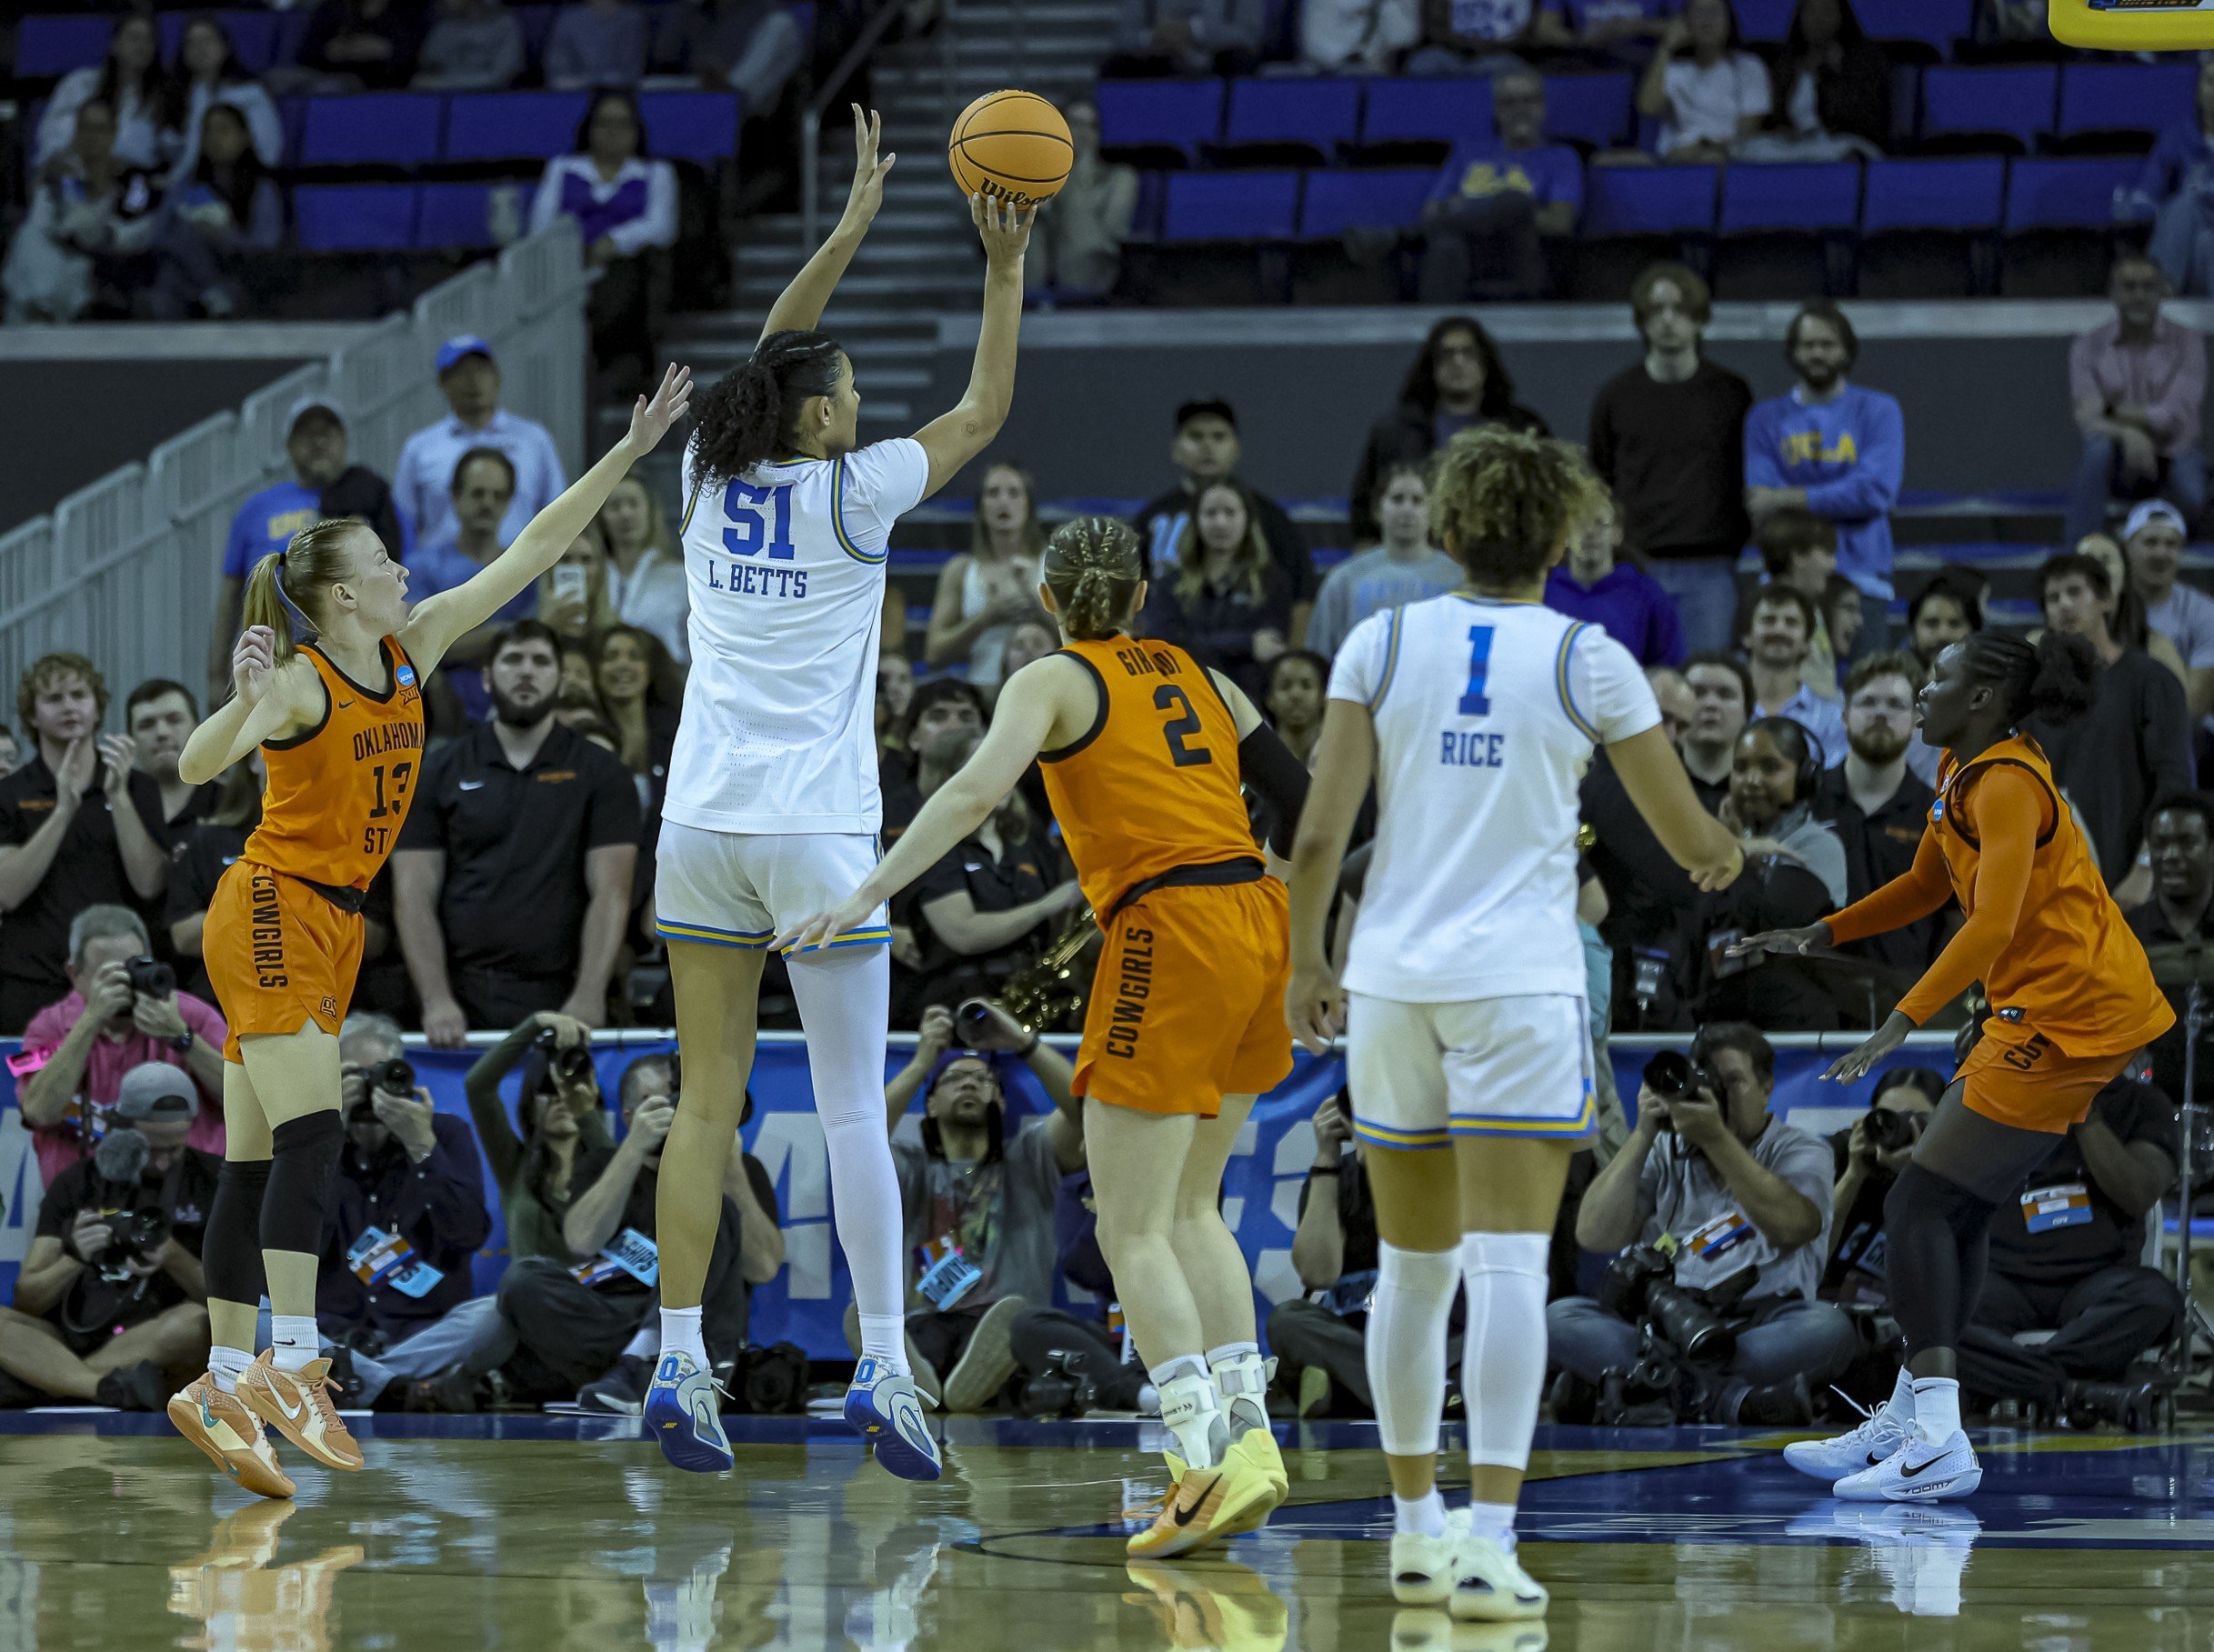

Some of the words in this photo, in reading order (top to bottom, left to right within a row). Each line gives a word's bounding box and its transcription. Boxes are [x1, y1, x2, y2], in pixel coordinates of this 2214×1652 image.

[980, 177, 1055, 206] Wilson
[723, 476, 795, 560] 51
[709, 560, 724, 589] L.
[729, 564, 807, 598] BETTS
[1458, 626, 1495, 716] 1
[1153, 685, 1212, 767] 2
[1441, 731, 1505, 767] RICE
[370, 762, 412, 818] 13
[252, 876, 288, 988] COWGIRLS
[1106, 926, 1155, 1059] COWGIRLS
